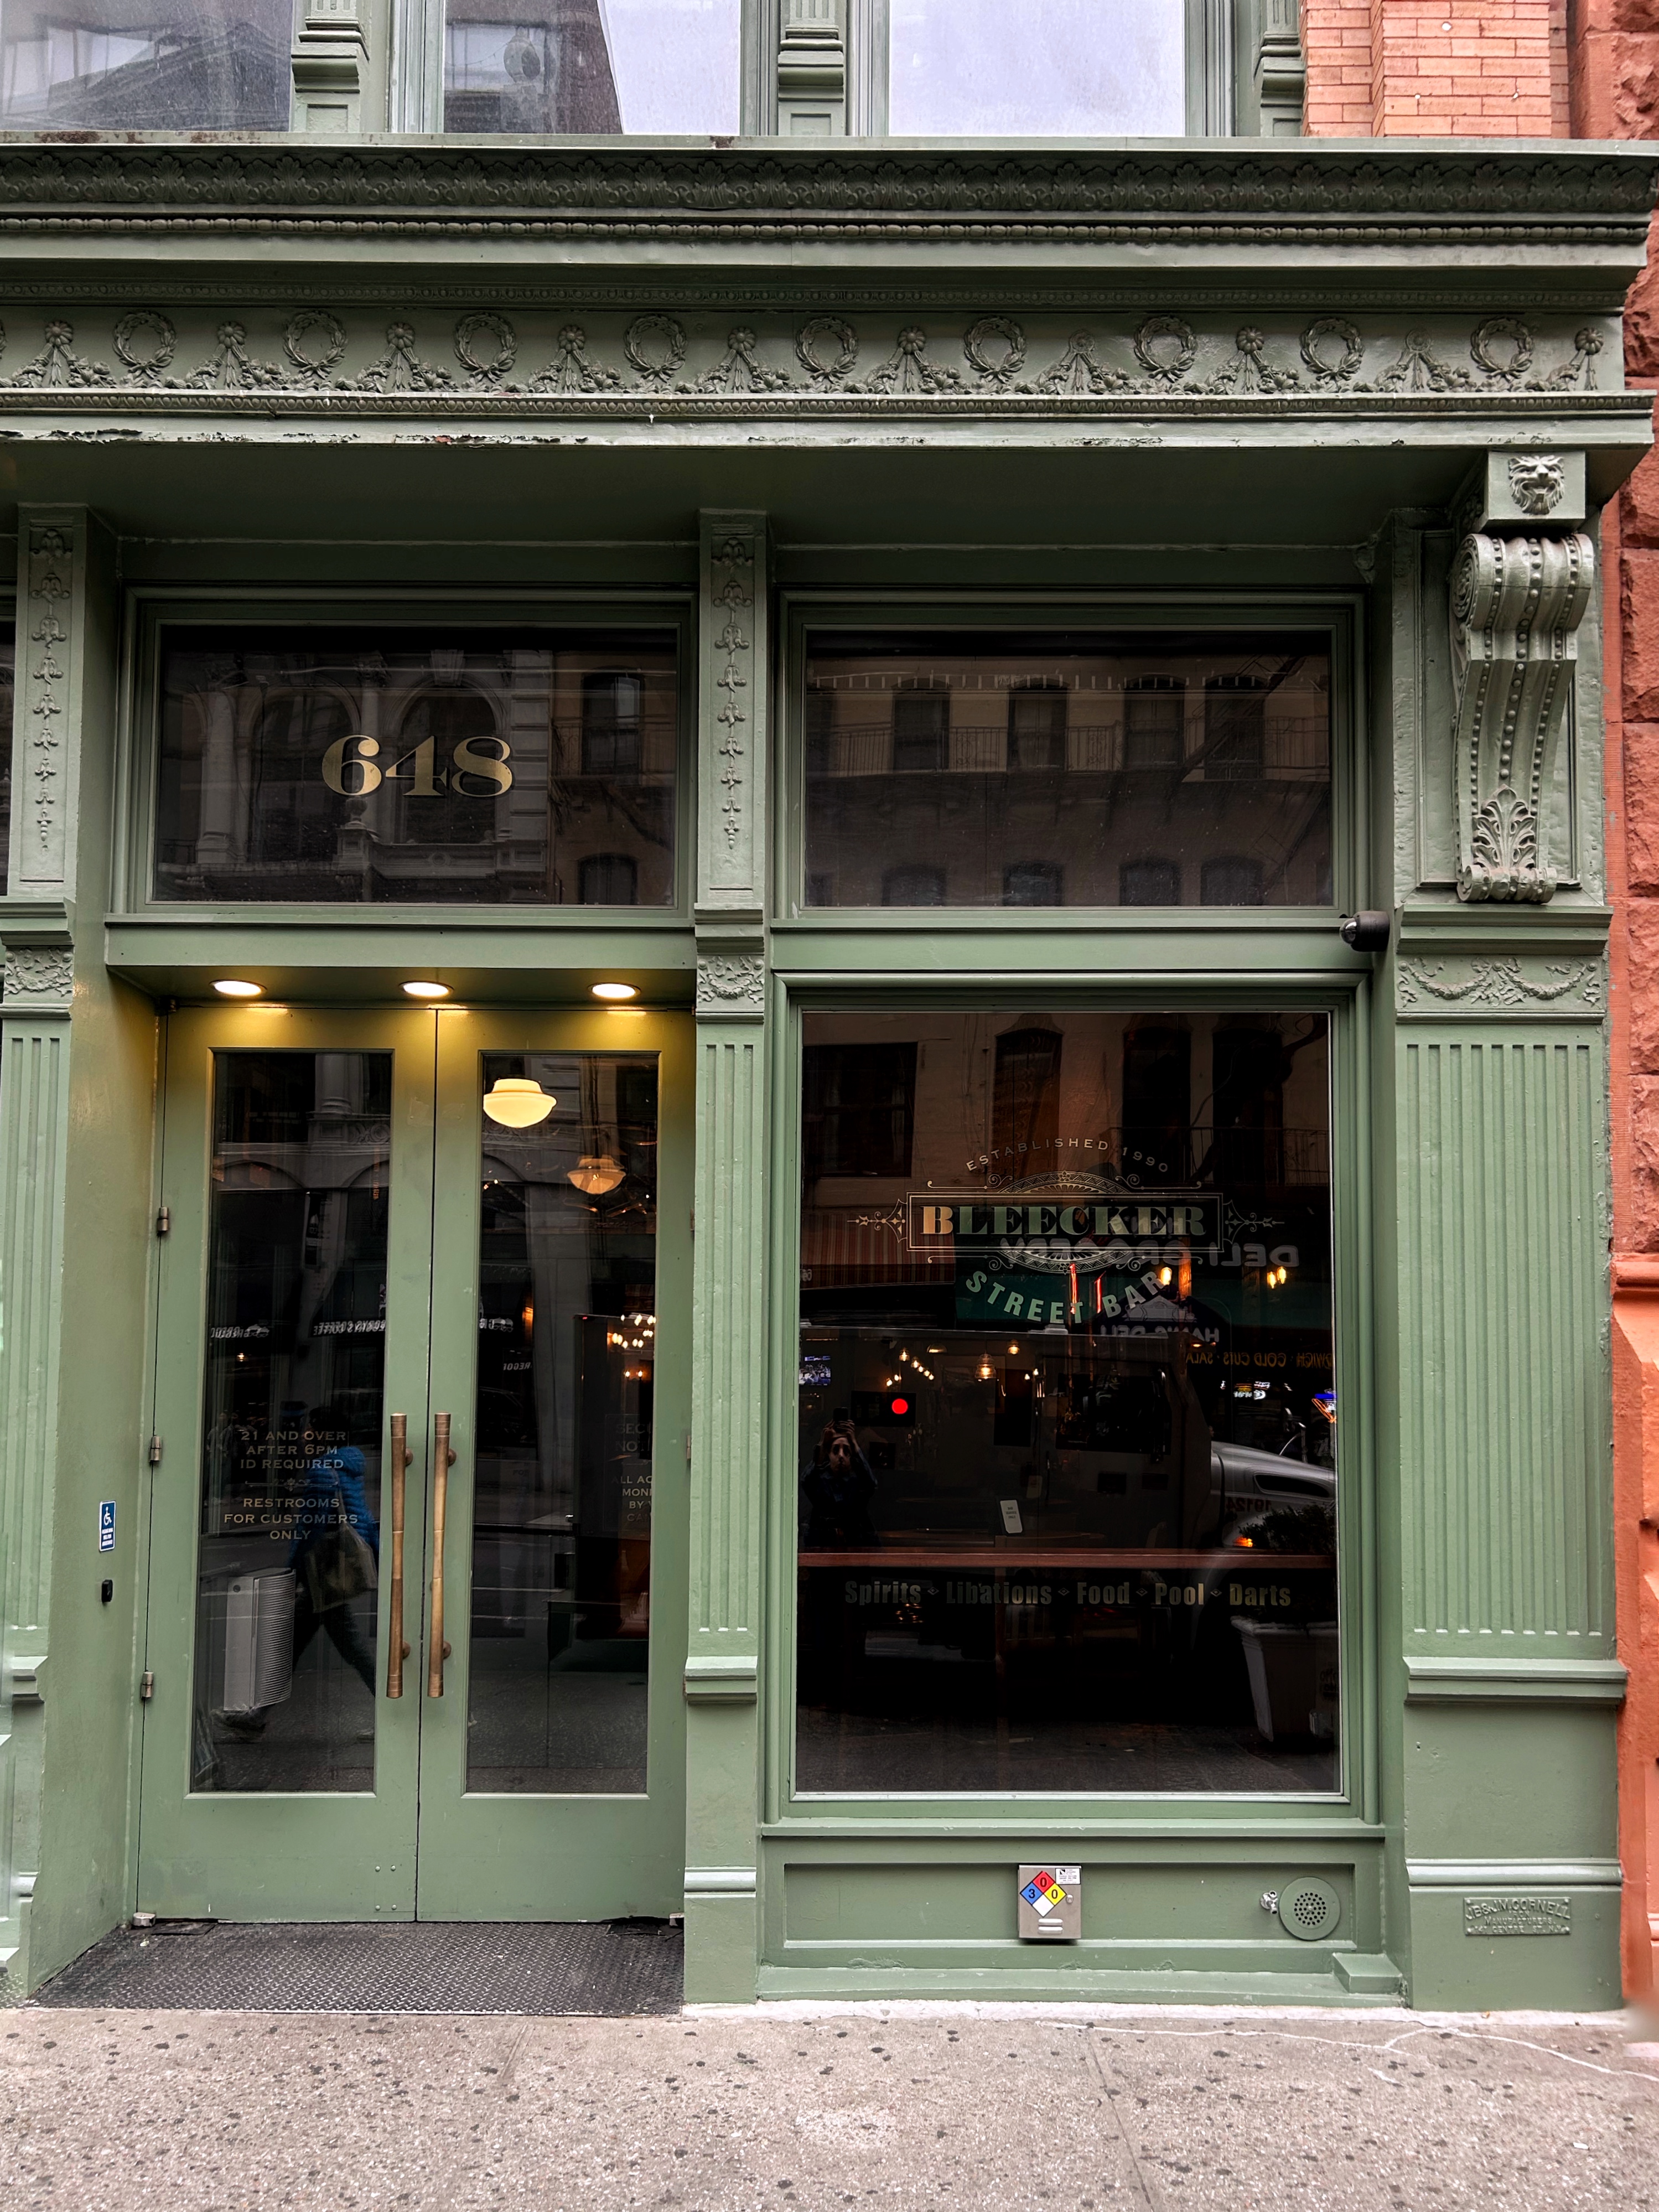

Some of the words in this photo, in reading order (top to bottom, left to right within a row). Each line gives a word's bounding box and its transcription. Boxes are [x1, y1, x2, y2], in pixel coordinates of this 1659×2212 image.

[322, 734, 512, 797] 648
[966, 1138, 1108, 1172] ESTABLISHED
[1122, 1147, 1168, 1172] 1990
[920, 1205, 1206, 1236] BLEECKER
[966, 1271, 1083, 1324] STREET
[1102, 1271, 1163, 1318] BAR
[241, 1431, 258, 1441] 21
[266, 1431, 298, 1441] AND
[304, 1431, 346, 1441] OVER
[246, 1446, 298, 1455] AFTER
[304, 1444, 338, 1455] 6PM
[241, 1459, 256, 1469] ID
[262, 1459, 344, 1469] REQUIRED
[243, 1498, 340, 1508] RESTROOMS
[629, 1501, 644, 1509] BY
[224, 1514, 255, 1524] FOR
[261, 1514, 358, 1524] CUSTOMERS
[269, 1530, 312, 1540] ONLY
[844, 1581, 921, 1605] Spirits
[946, 1581, 1053, 1605] Libations
[1077, 1582, 1129, 1604] Food
[1155, 1583, 1204, 1605] Pool
[1230, 1584, 1291, 1607] Darts
[1040, 1877, 1047, 1887] 0
[1028, 1889, 1035, 1899] 3
[1051, 1889, 1058, 1899] 0
